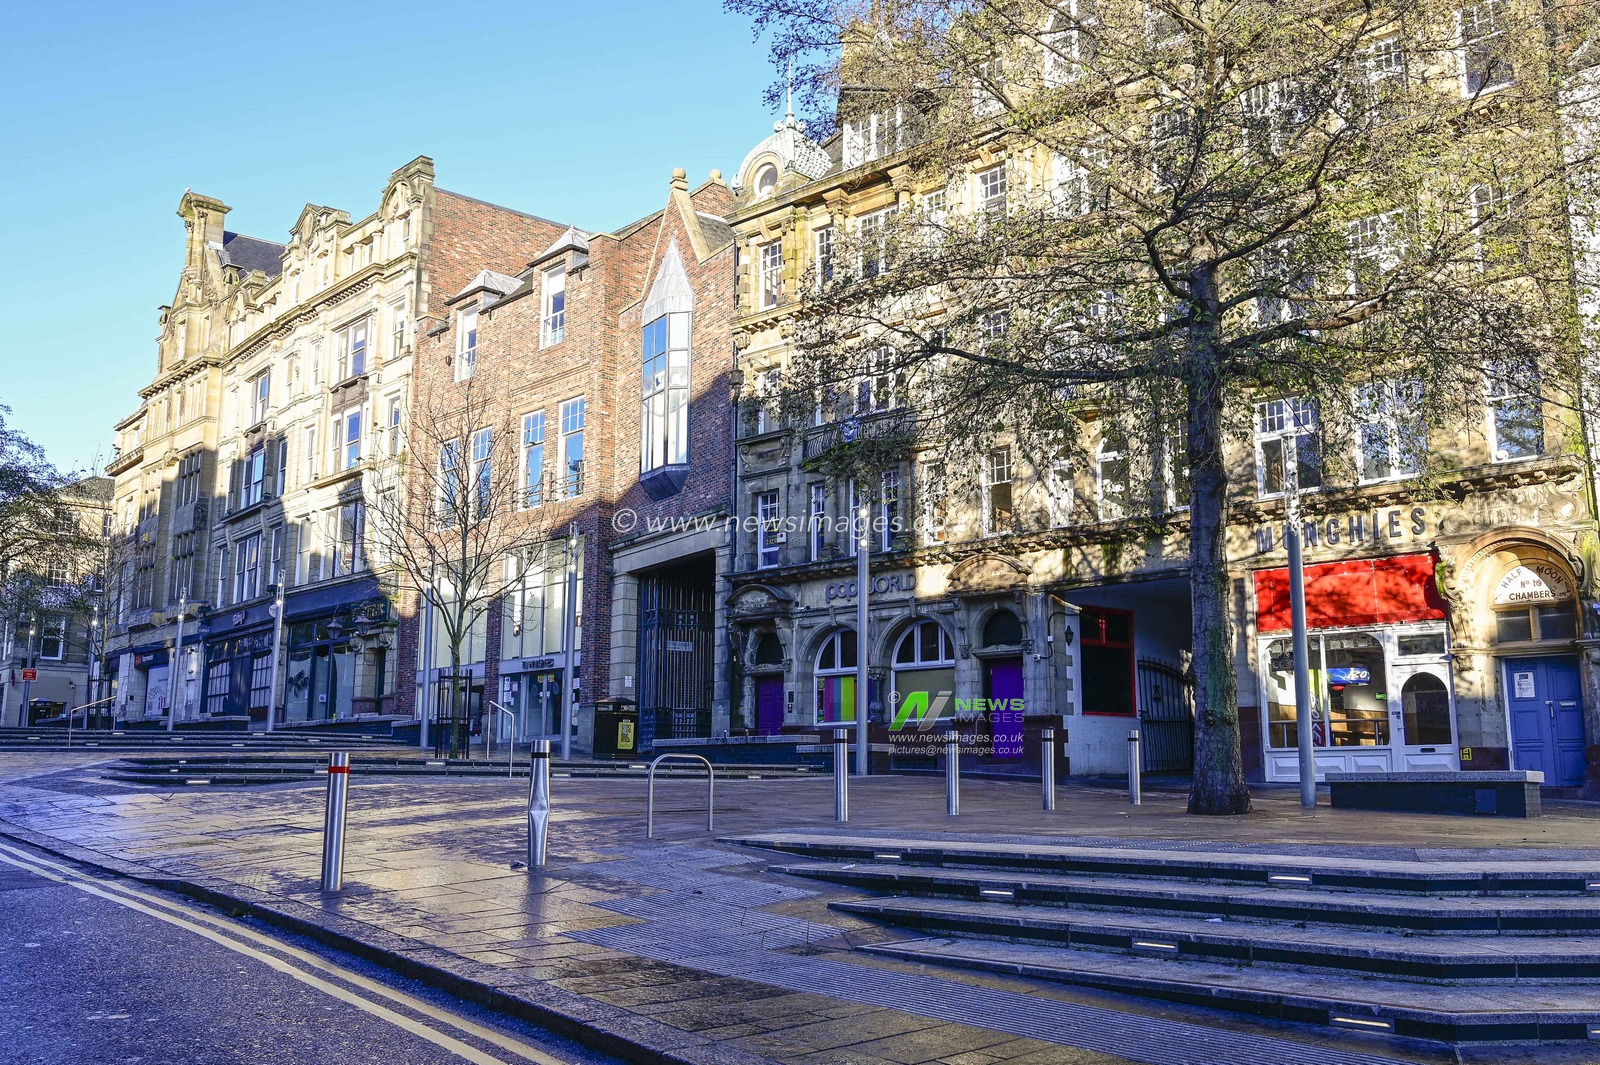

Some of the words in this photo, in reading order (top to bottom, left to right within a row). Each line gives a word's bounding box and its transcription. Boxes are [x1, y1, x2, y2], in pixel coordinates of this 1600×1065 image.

[1501, 568, 1522, 588] HALF
[1536, 565, 1563, 584] MOON
[1509, 590, 1556, 600] CHAMBERS
